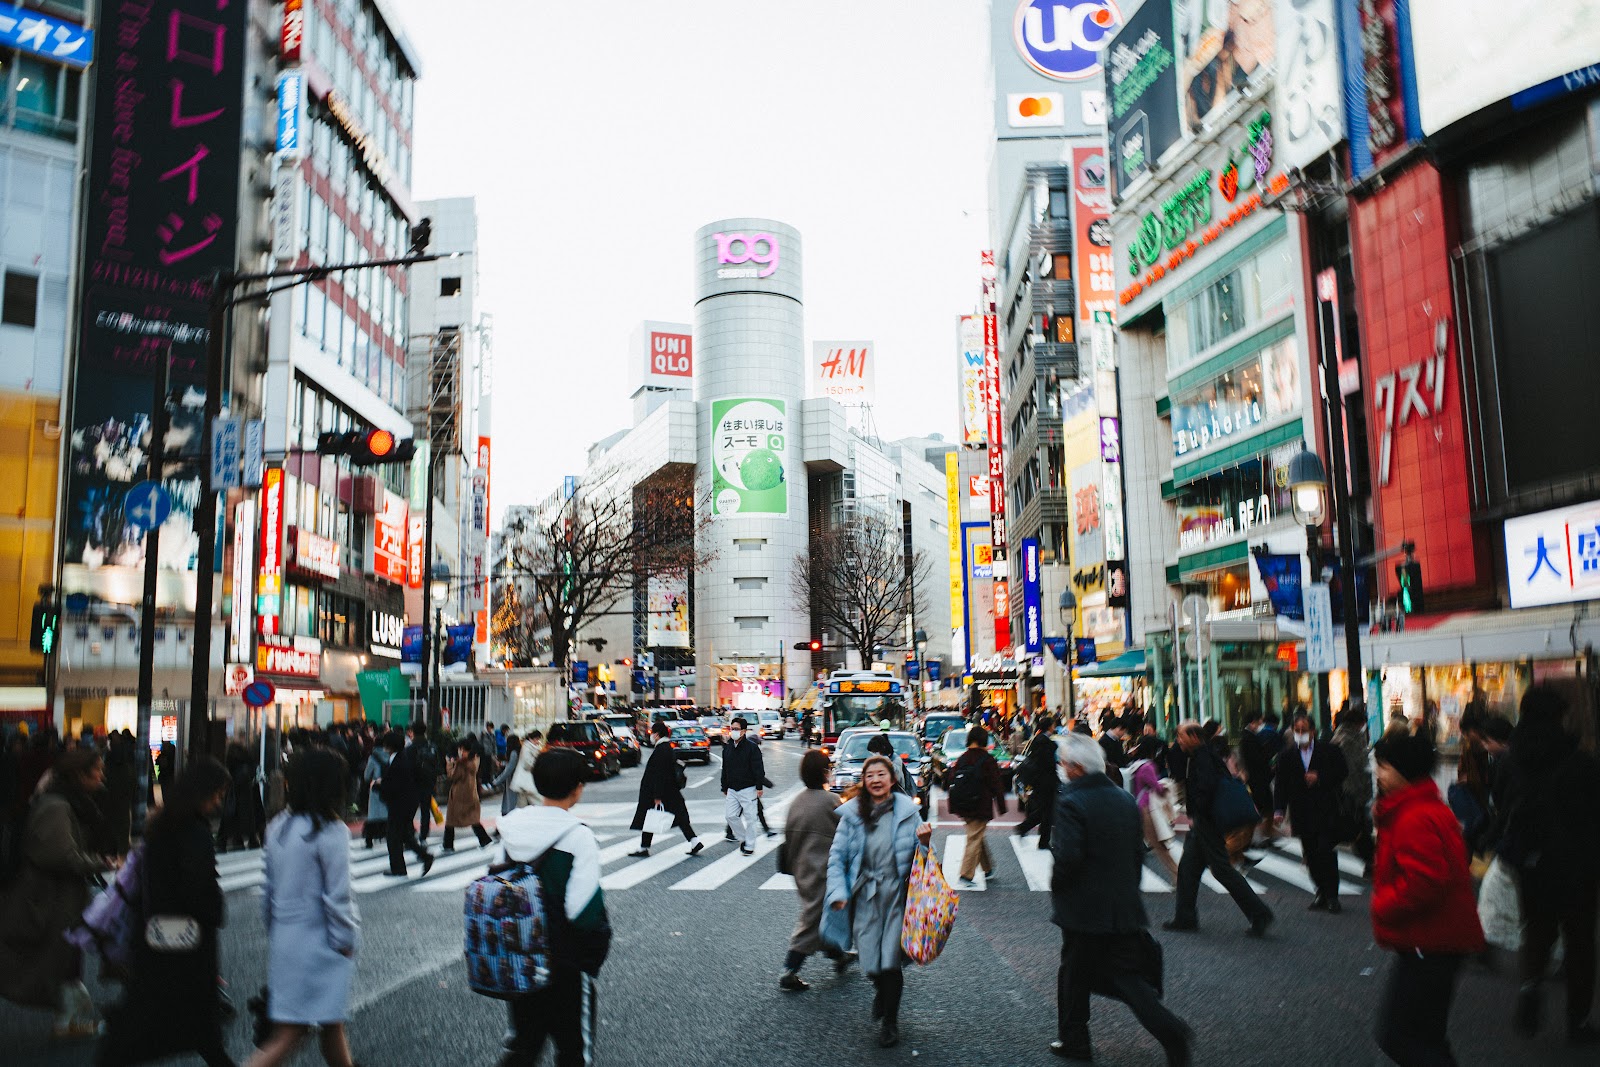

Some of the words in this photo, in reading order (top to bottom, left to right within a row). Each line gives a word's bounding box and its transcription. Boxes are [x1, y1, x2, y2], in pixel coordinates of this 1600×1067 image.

[712, 233, 780, 278] 109
[654, 336, 687, 355] UNI
[654, 353, 690, 373] QLO
[819, 347, 867, 379] H&M
[825, 386, 854, 395] 150m
[1375, 315, 1448, 487] クスリ
[723, 418, 784, 432] 住まい探しは
[1176, 401, 1262, 454] Euphoria
[723, 435, 758, 449] スーモ
[371, 610, 404, 647] LUSH
